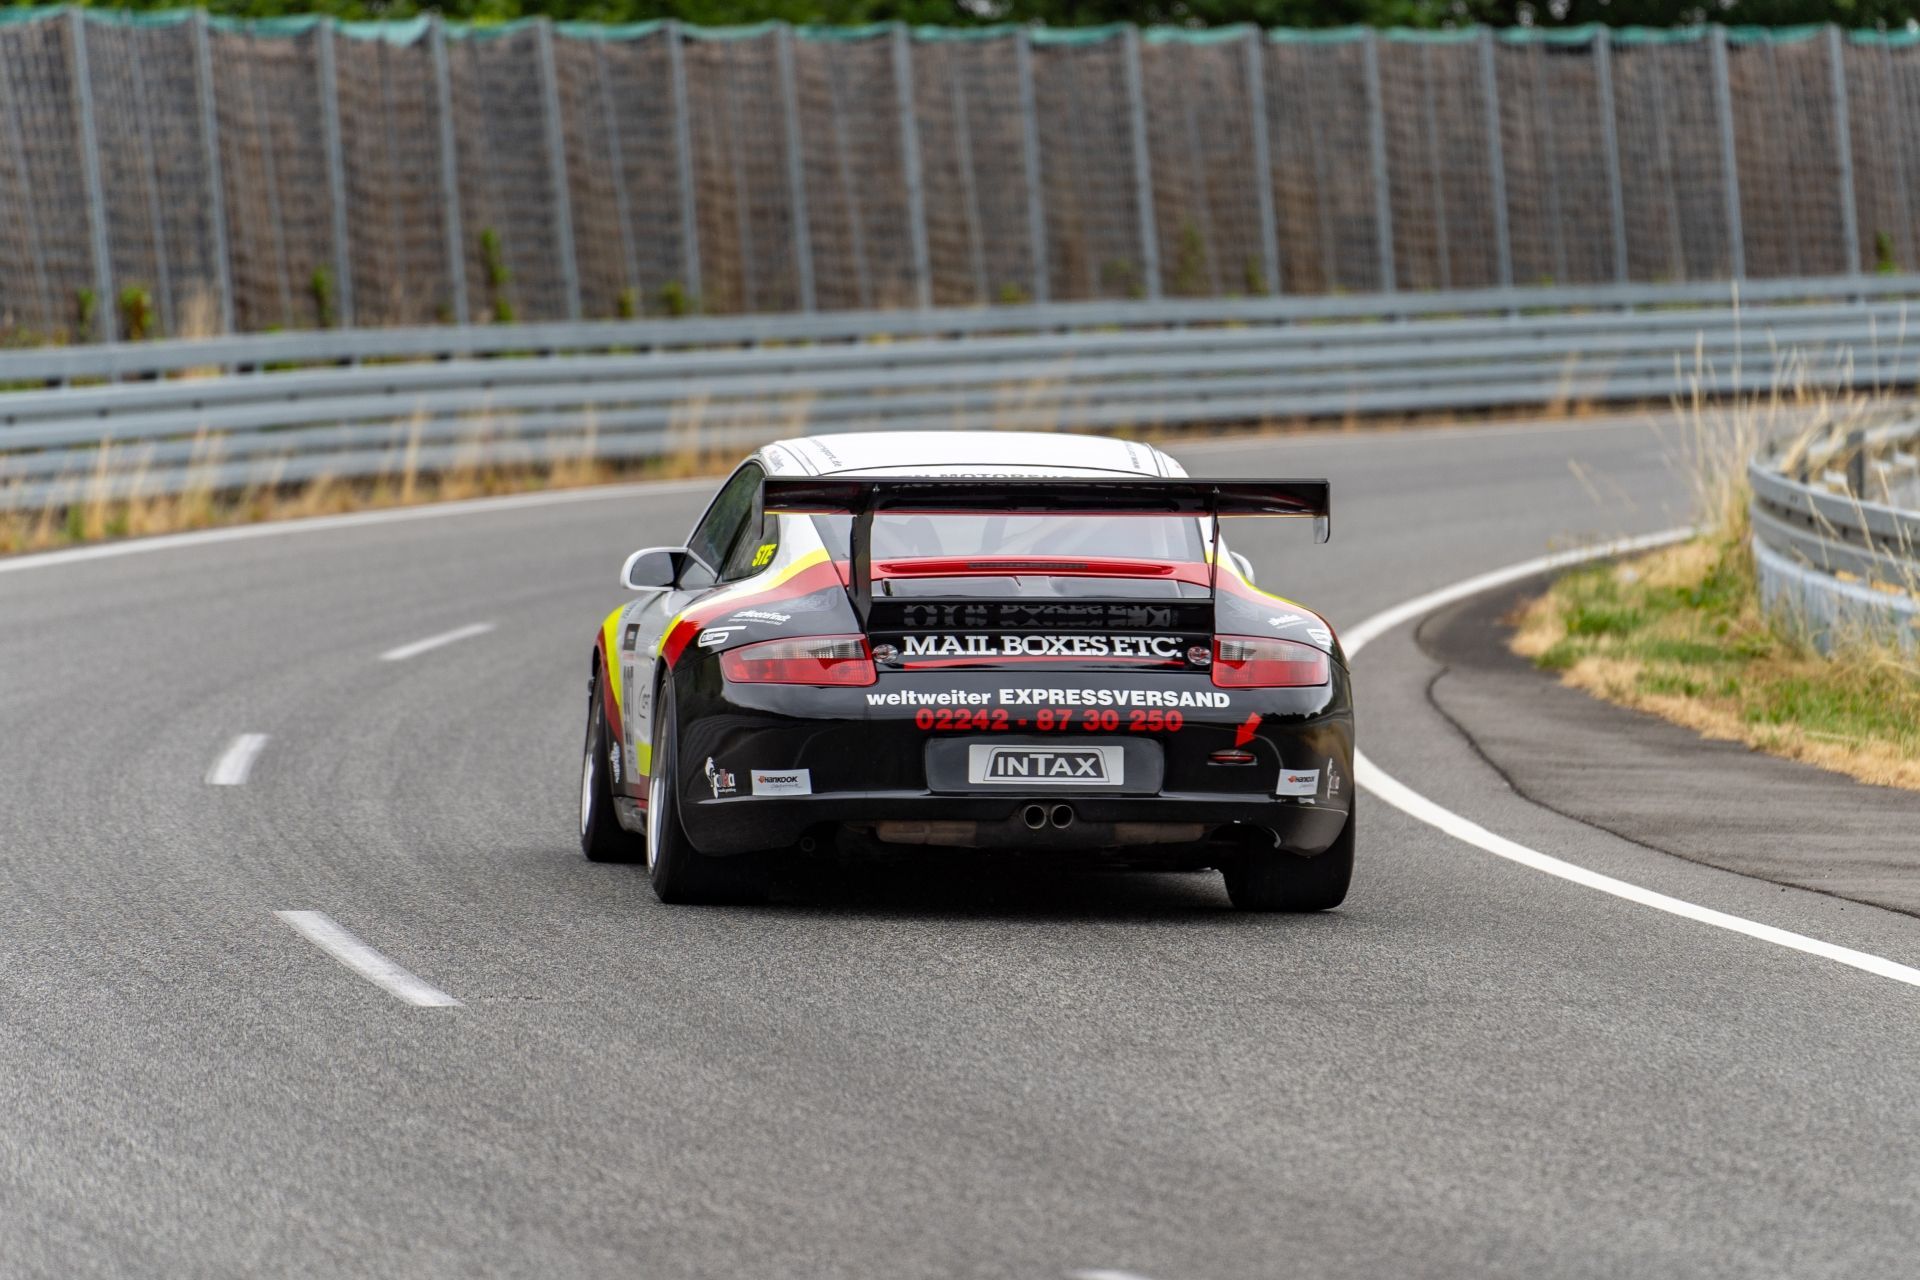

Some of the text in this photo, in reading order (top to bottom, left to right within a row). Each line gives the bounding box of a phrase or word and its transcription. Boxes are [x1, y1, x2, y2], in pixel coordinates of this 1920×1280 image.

[903, 635, 998, 656] MAIL
[1000, 635, 1109, 657] BOXES
[866, 688, 1231, 708] weltweiter EXPRESSVERSAND
[915, 708, 1009, 730] 02242
[1036, 708, 1073, 731] 87
[1082, 708, 1119, 732] 30
[1129, 709, 1184, 732] 250
[997, 753, 1098, 777] INTAX
